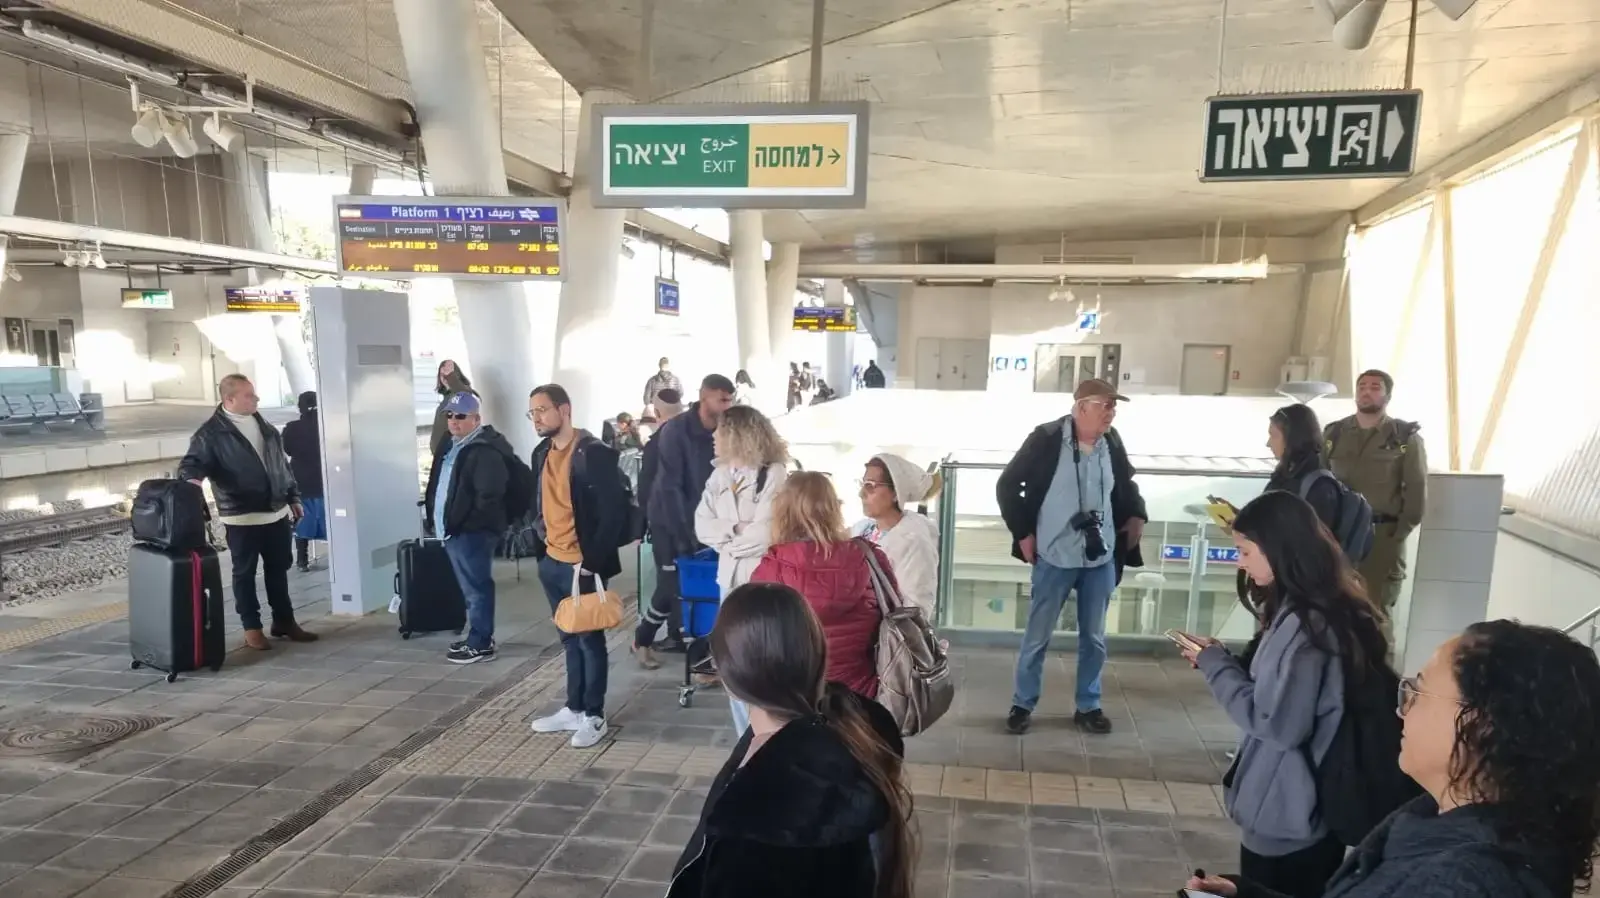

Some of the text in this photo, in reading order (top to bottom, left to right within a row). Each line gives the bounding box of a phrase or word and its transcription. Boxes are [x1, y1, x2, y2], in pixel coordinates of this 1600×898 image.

[700, 135, 738, 154] خروج
[1214, 104, 1328, 169] יציאה
[615, 143, 686, 165] יציאה
[754, 143, 824, 168] למחסה
[703, 159, 737, 173] EXIT
[391, 206, 450, 218] Platform 1
[456, 207, 484, 221] רציף
[488, 207, 515, 220] رصيف
